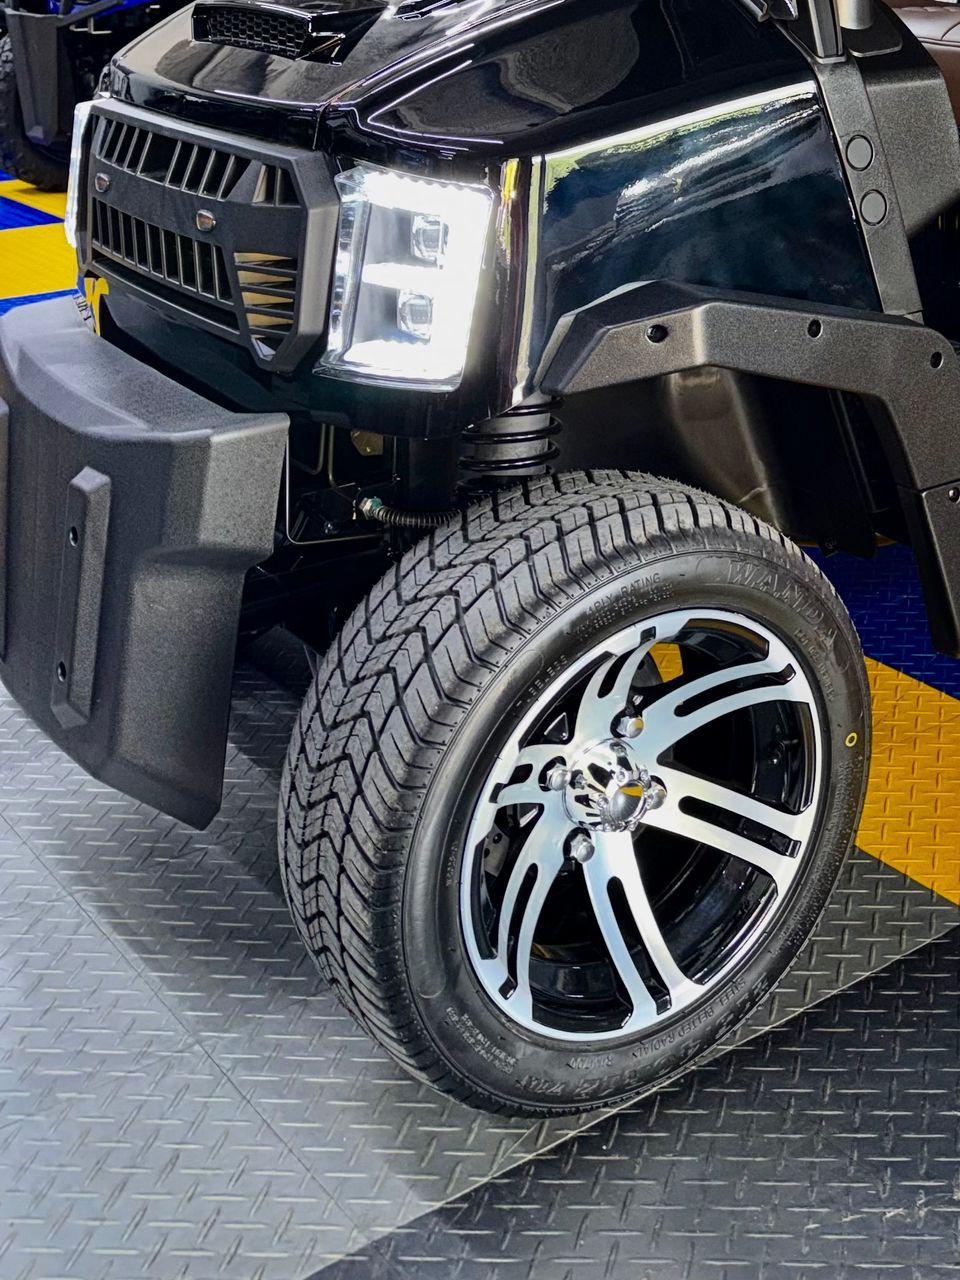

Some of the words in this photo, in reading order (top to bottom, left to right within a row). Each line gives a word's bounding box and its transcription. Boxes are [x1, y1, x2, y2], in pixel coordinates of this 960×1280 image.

[620, 572, 661, 597] RATING
[718, 977, 747, 1007] STEEL
[677, 1007, 716, 1039] BELTED
[639, 1030, 676, 1056] RADIAL
